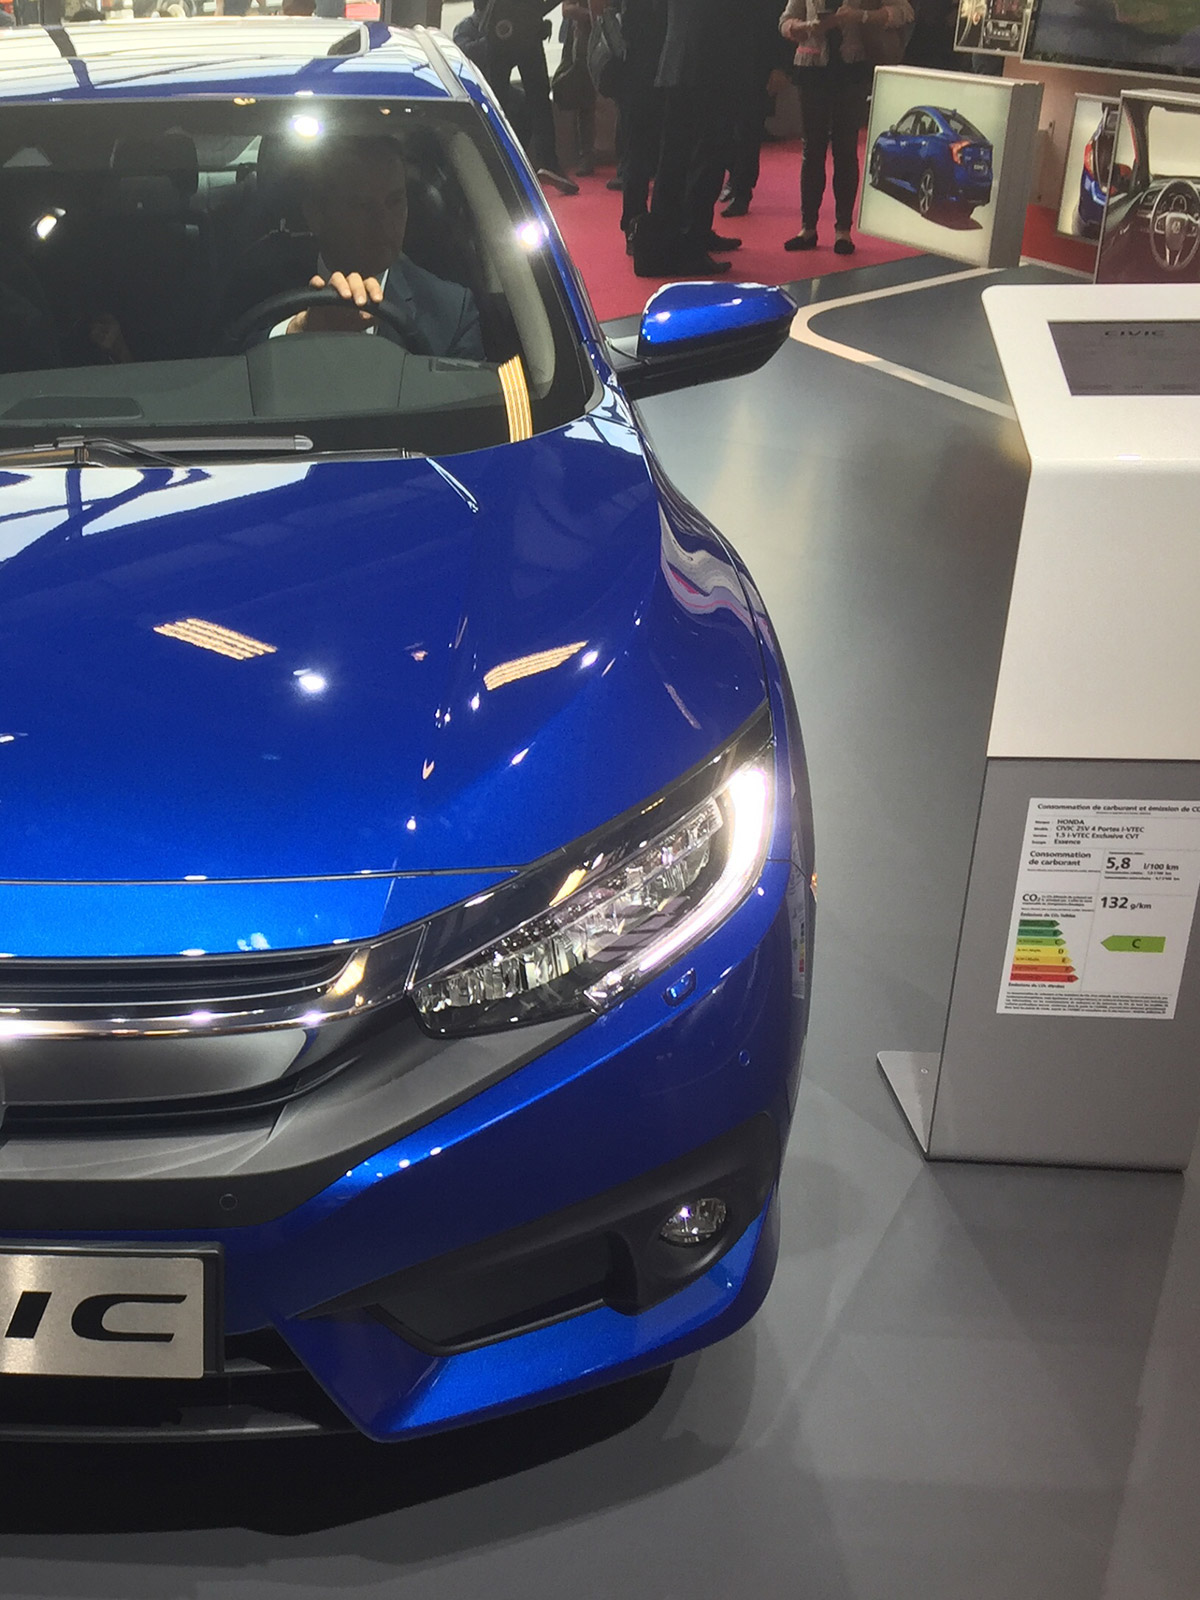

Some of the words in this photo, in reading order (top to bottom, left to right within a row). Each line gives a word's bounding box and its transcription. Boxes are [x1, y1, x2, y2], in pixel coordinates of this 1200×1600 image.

[1029, 850, 1092, 859] Consommation
[1028, 858, 1040, 866] de
[1106, 857, 1131, 870] 5,8
[1165, 863, 1179, 871] km
[1101, 896, 1129, 909] 132
[1130, 902, 1152, 910] g/km
[1131, 938, 1141, 949] C
